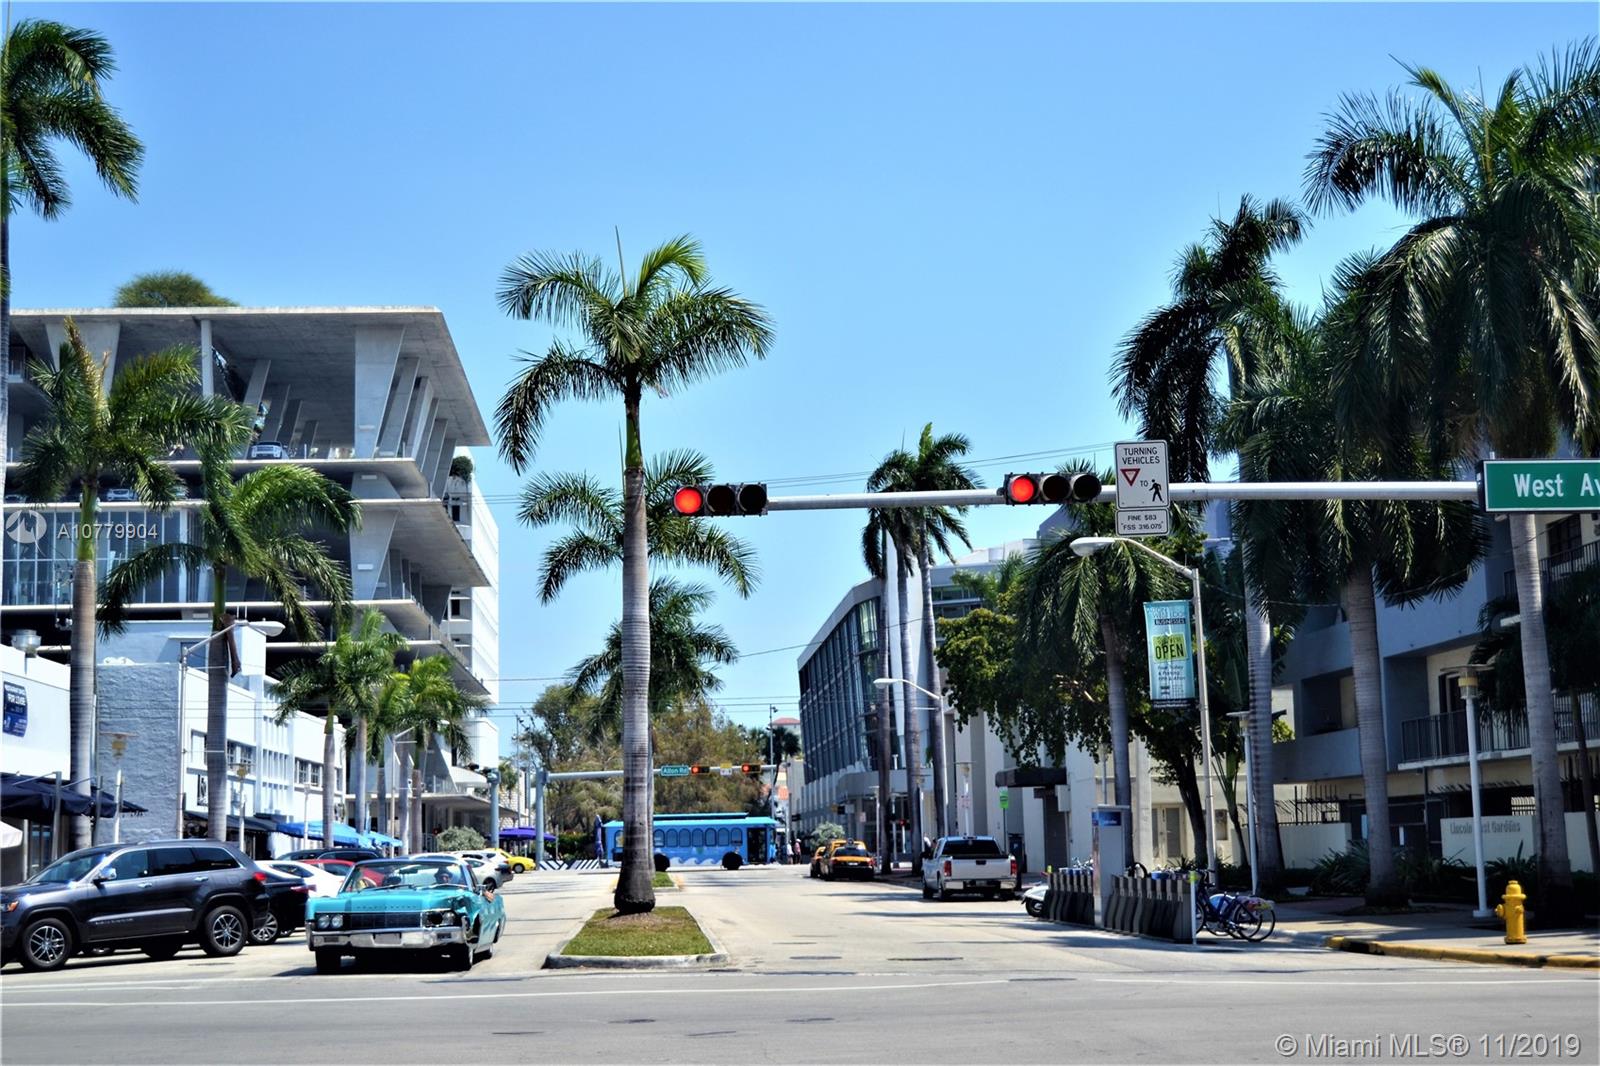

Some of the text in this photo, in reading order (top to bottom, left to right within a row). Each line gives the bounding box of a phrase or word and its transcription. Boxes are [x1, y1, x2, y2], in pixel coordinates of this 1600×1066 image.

[1123, 447, 1158, 456] TURNING
[1122, 456, 1160, 465] VEHICLES
[1513, 473, 1564, 497] West
[1123, 523, 1136, 531] FSS
[1155, 643, 1185, 660] OPEN
